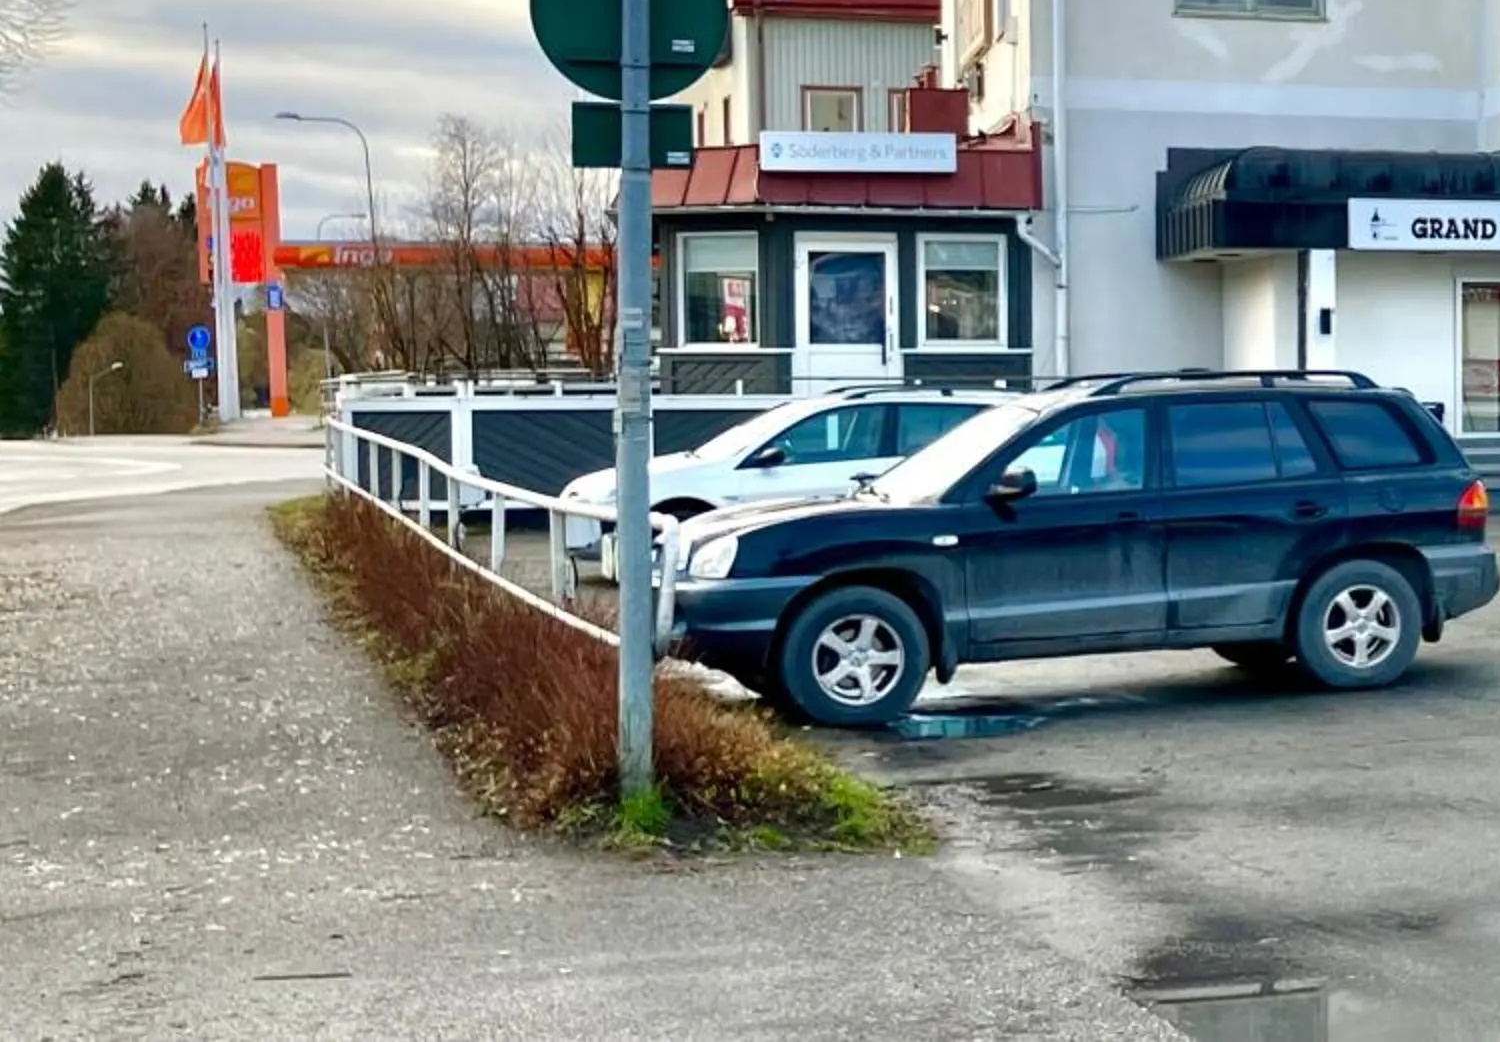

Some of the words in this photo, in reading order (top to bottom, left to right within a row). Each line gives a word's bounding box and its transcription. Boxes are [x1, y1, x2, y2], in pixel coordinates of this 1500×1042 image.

[789, 141, 866, 162] Söderberg
[871, 144, 881, 158] &
[885, 144, 947, 158] Partners
[1411, 217, 1497, 241] GRAND
